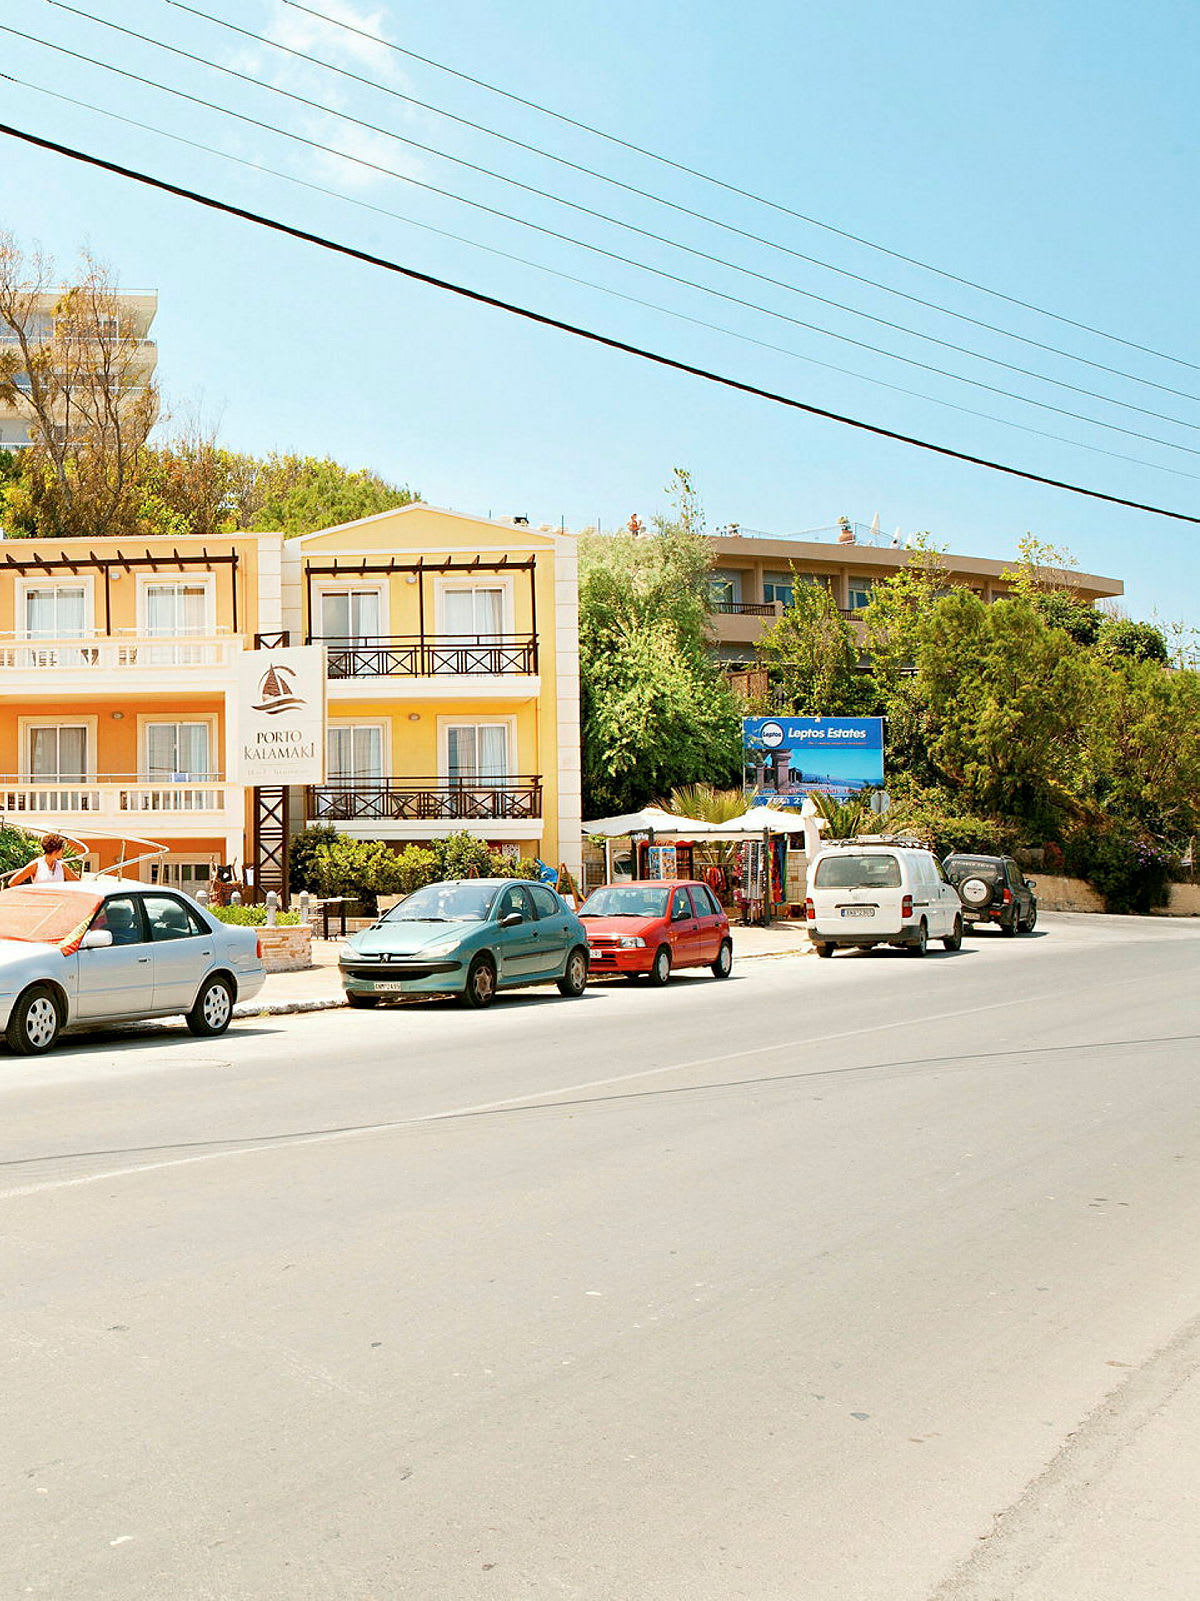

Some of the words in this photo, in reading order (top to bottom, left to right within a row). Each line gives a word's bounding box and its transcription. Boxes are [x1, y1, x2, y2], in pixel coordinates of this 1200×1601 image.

[256, 730, 303, 744] PORTO
[788, 727, 825, 740] Leptos
[827, 727, 867, 739] Estates
[244, 742, 315, 760] KALAMAKI
